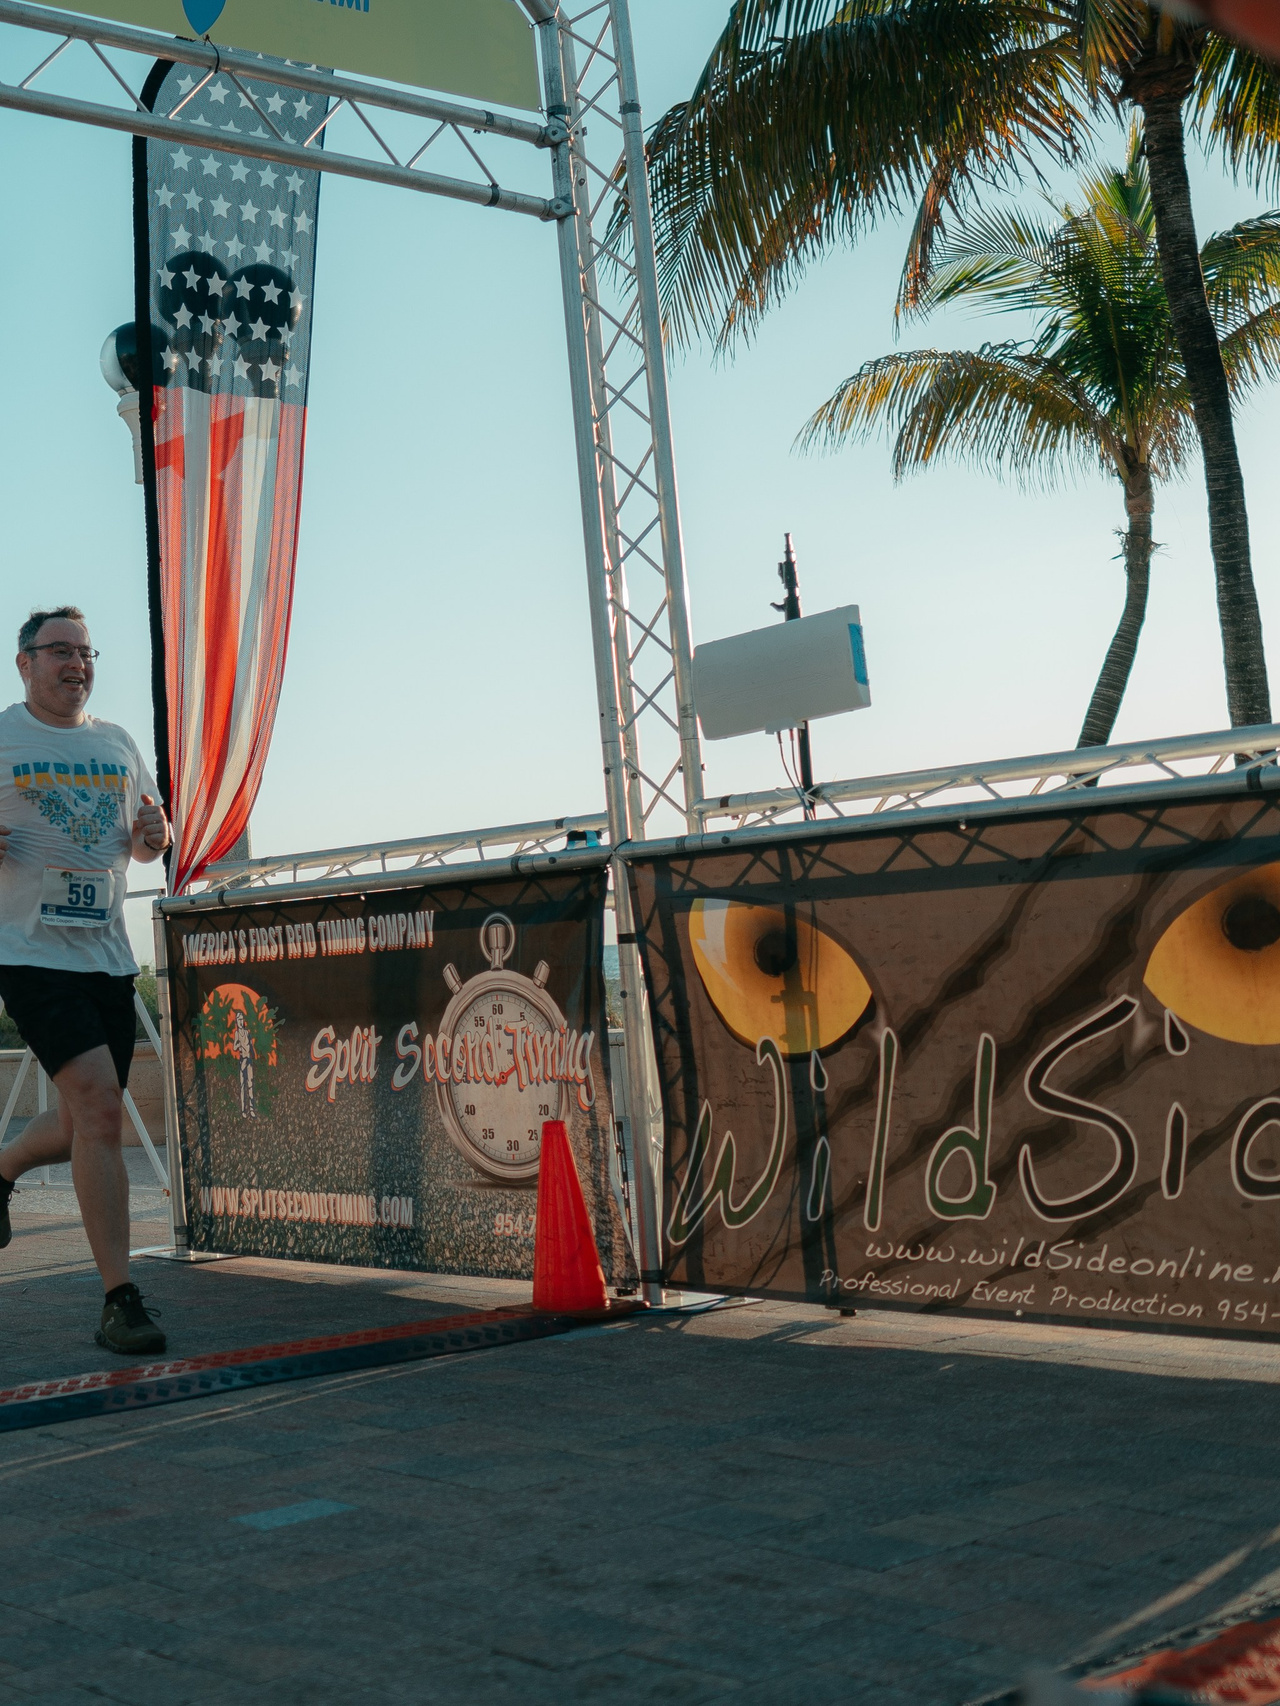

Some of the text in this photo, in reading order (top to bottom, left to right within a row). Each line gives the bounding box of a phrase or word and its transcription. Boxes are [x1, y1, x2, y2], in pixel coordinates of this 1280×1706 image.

[67, 883, 96, 907] 59
[182, 910, 435, 967] AMERICA'S FIRST RFID TIMING COMPANY
[492, 1003, 503, 1015] 60
[474, 1016, 485, 1027] 55
[305, 1019, 596, 1113] Split Second Timing
[464, 1104, 476, 1116] 40
[538, 1104, 549, 1116] 20
[482, 1128, 495, 1140] 35
[528, 1129, 538, 1141] 25
[506, 1140, 519, 1152] 30
[200, 1186, 413, 1229] WWW.SPLITSECONDTIMING.COM
[494, 1212, 536, 1238] 954.7
[819, 1268, 961, 1299] Professional
[971, 1280, 1035, 1305] Event
[1049, 1286, 1204, 1318] Production
